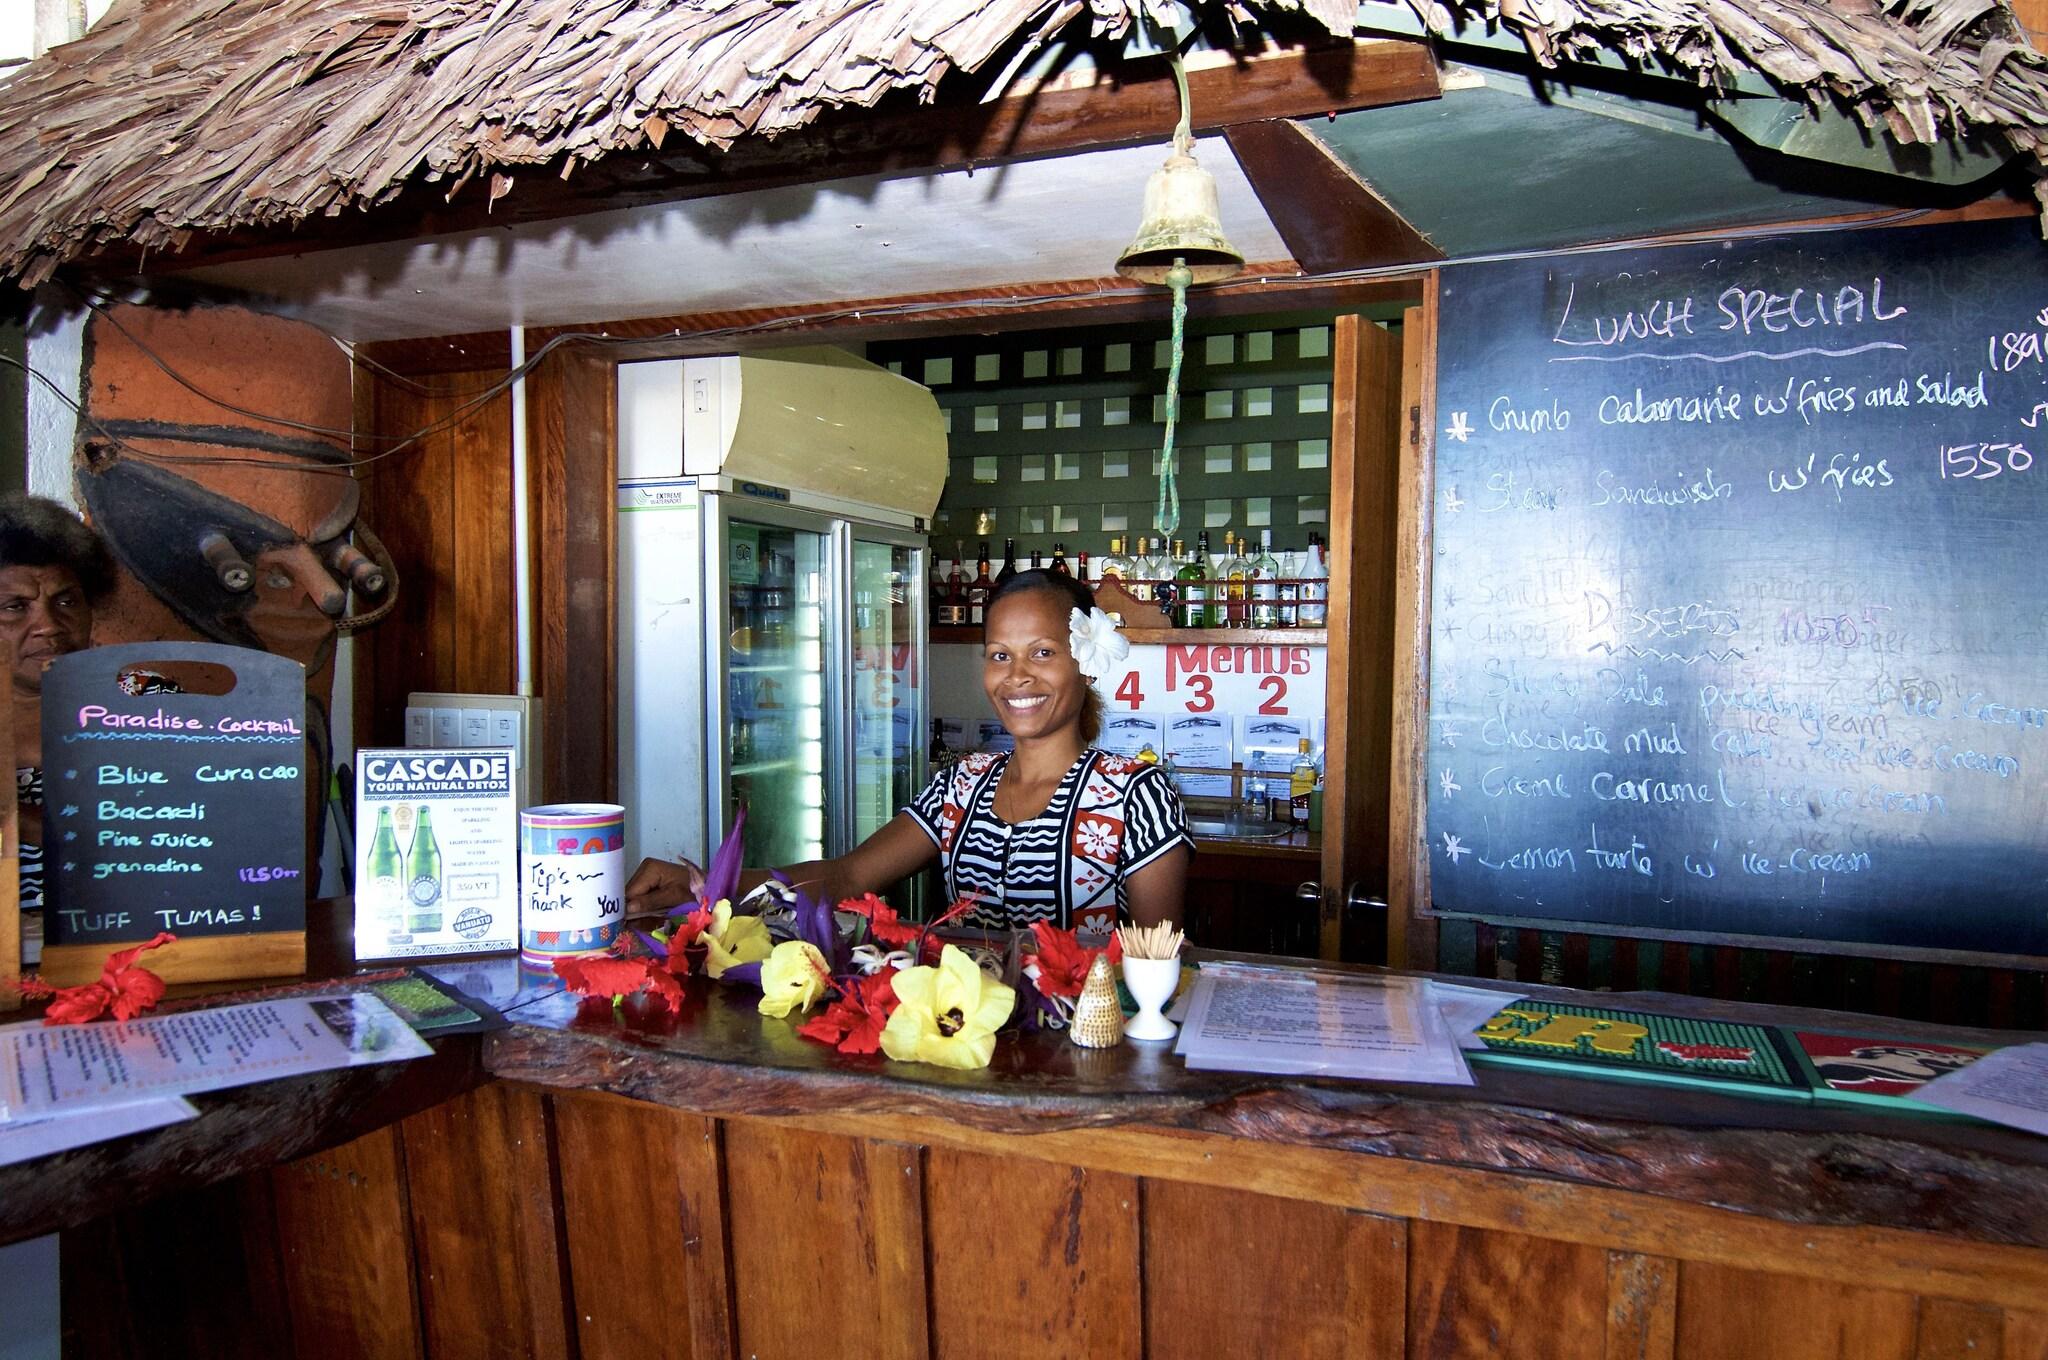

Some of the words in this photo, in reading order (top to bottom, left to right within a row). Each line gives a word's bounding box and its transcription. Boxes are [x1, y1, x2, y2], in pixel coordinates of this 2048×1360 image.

[1718, 277, 1908, 335] SPECIAL
[1865, 377, 1910, 408] and
[1821, 452, 1895, 503] fries
[1940, 442, 2034, 480] 1550
[1166, 645, 1311, 691] Menus
[1115, 671, 1145, 710] 4
[1185, 675, 1215, 713] 3
[1258, 676, 1289, 715] 2
[78, 705, 203, 730] Paradise
[97, 765, 169, 786] Blue
[366, 758, 507, 782] CASCADE
[367, 782, 405, 792] YOUR
[406, 781, 464, 791] NATURAL
[466, 780, 508, 790] DETOX
[1591, 767, 1747, 808] Caramel
[97, 800, 206, 822] Bacardi
[97, 830, 143, 848] Pine
[150, 832, 214, 848] Juice
[1478, 815, 1577, 873] Lemon
[92, 860, 203, 880] grenadine
[57, 908, 132, 934] TUFF
[454, 915, 491, 932] VANUATU
